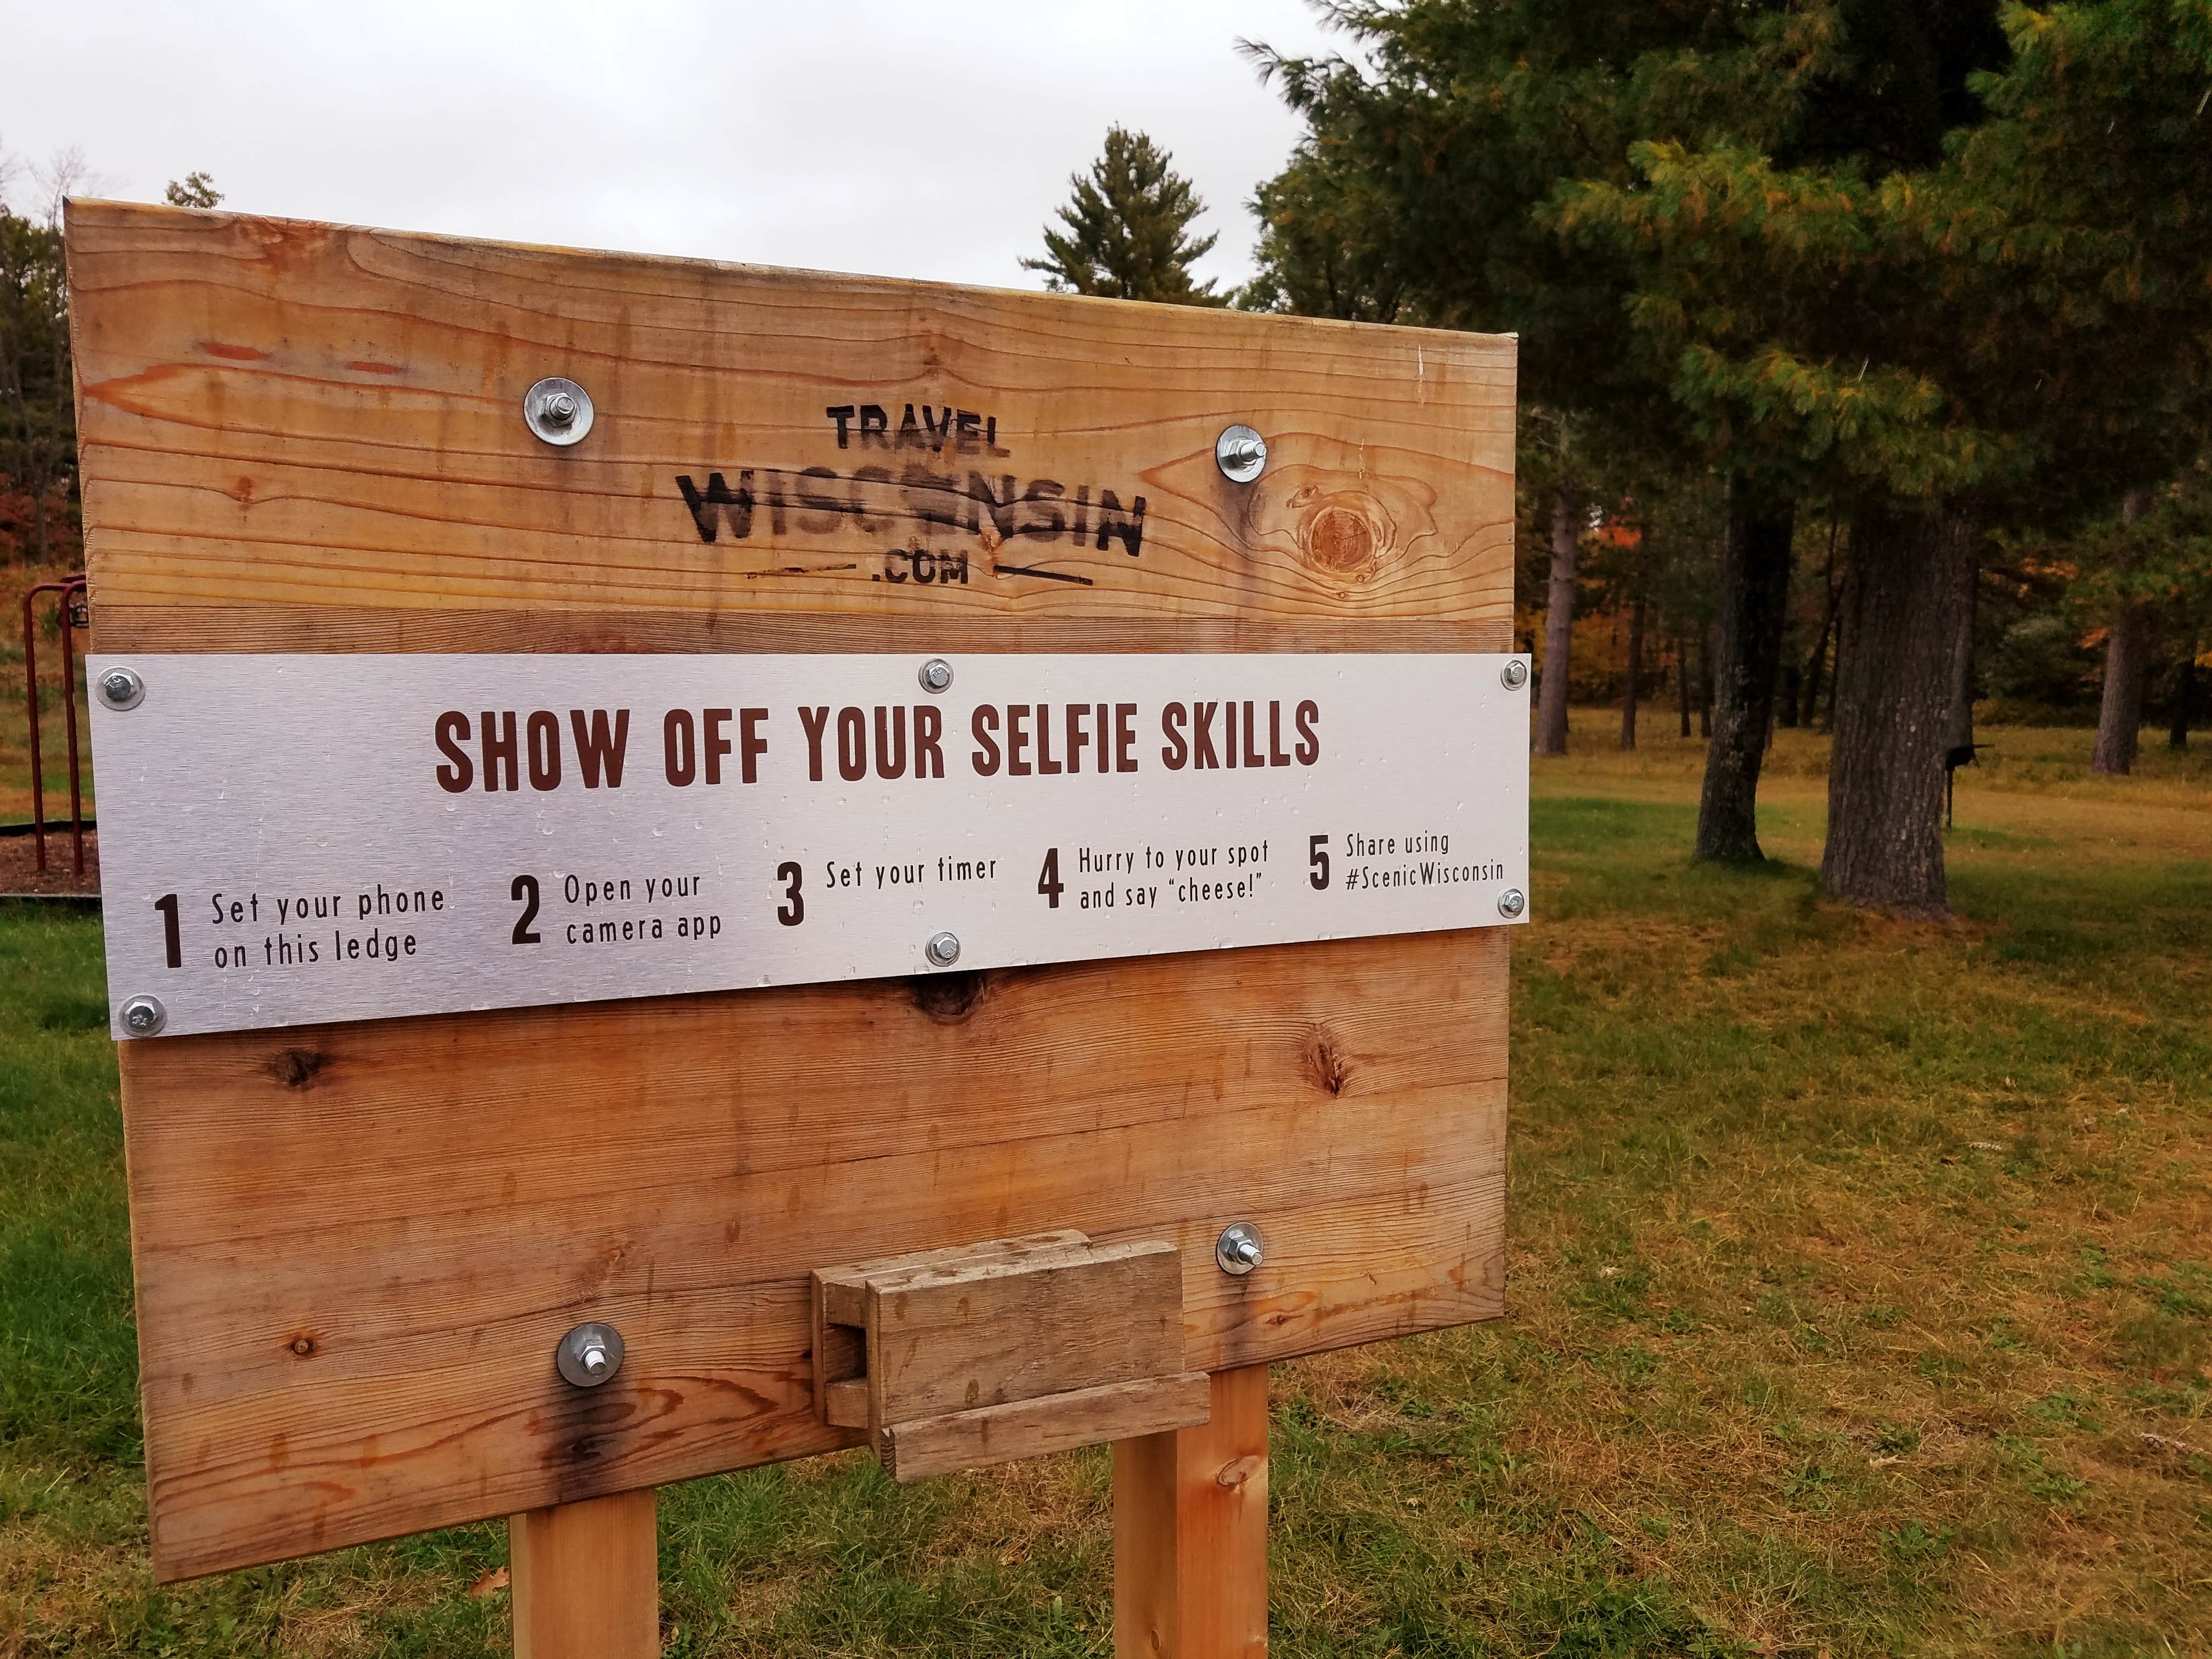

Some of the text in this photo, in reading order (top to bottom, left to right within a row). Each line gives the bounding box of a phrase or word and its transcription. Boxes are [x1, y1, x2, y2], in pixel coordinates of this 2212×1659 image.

[826, 404, 1011, 458] TRAVEL
[871, 549, 969, 585] .COM
[435, 699, 1319, 793] SHOW OFF YOUR SELFIE SKILLS
[1079, 839, 1268, 874] Hurry to your spot
[1310, 834, 1330, 890] 5
[1346, 830, 1448, 857] Share using
[564, 874, 700, 907] Open your
[826, 855, 996, 889] Set your timer
[1037, 848, 1064, 909] 4
[1080, 872, 1262, 910] and say “cheese!”
[1345, 859, 1503, 889] #ScenicWisconsin
[212, 883, 444, 926] Set your phone
[511, 874, 541, 945] 2
[777, 861, 804, 927] 3
[154, 894, 182, 969] 1
[215, 927, 416, 969] on this ledge
[566, 915, 721, 944] camera app
